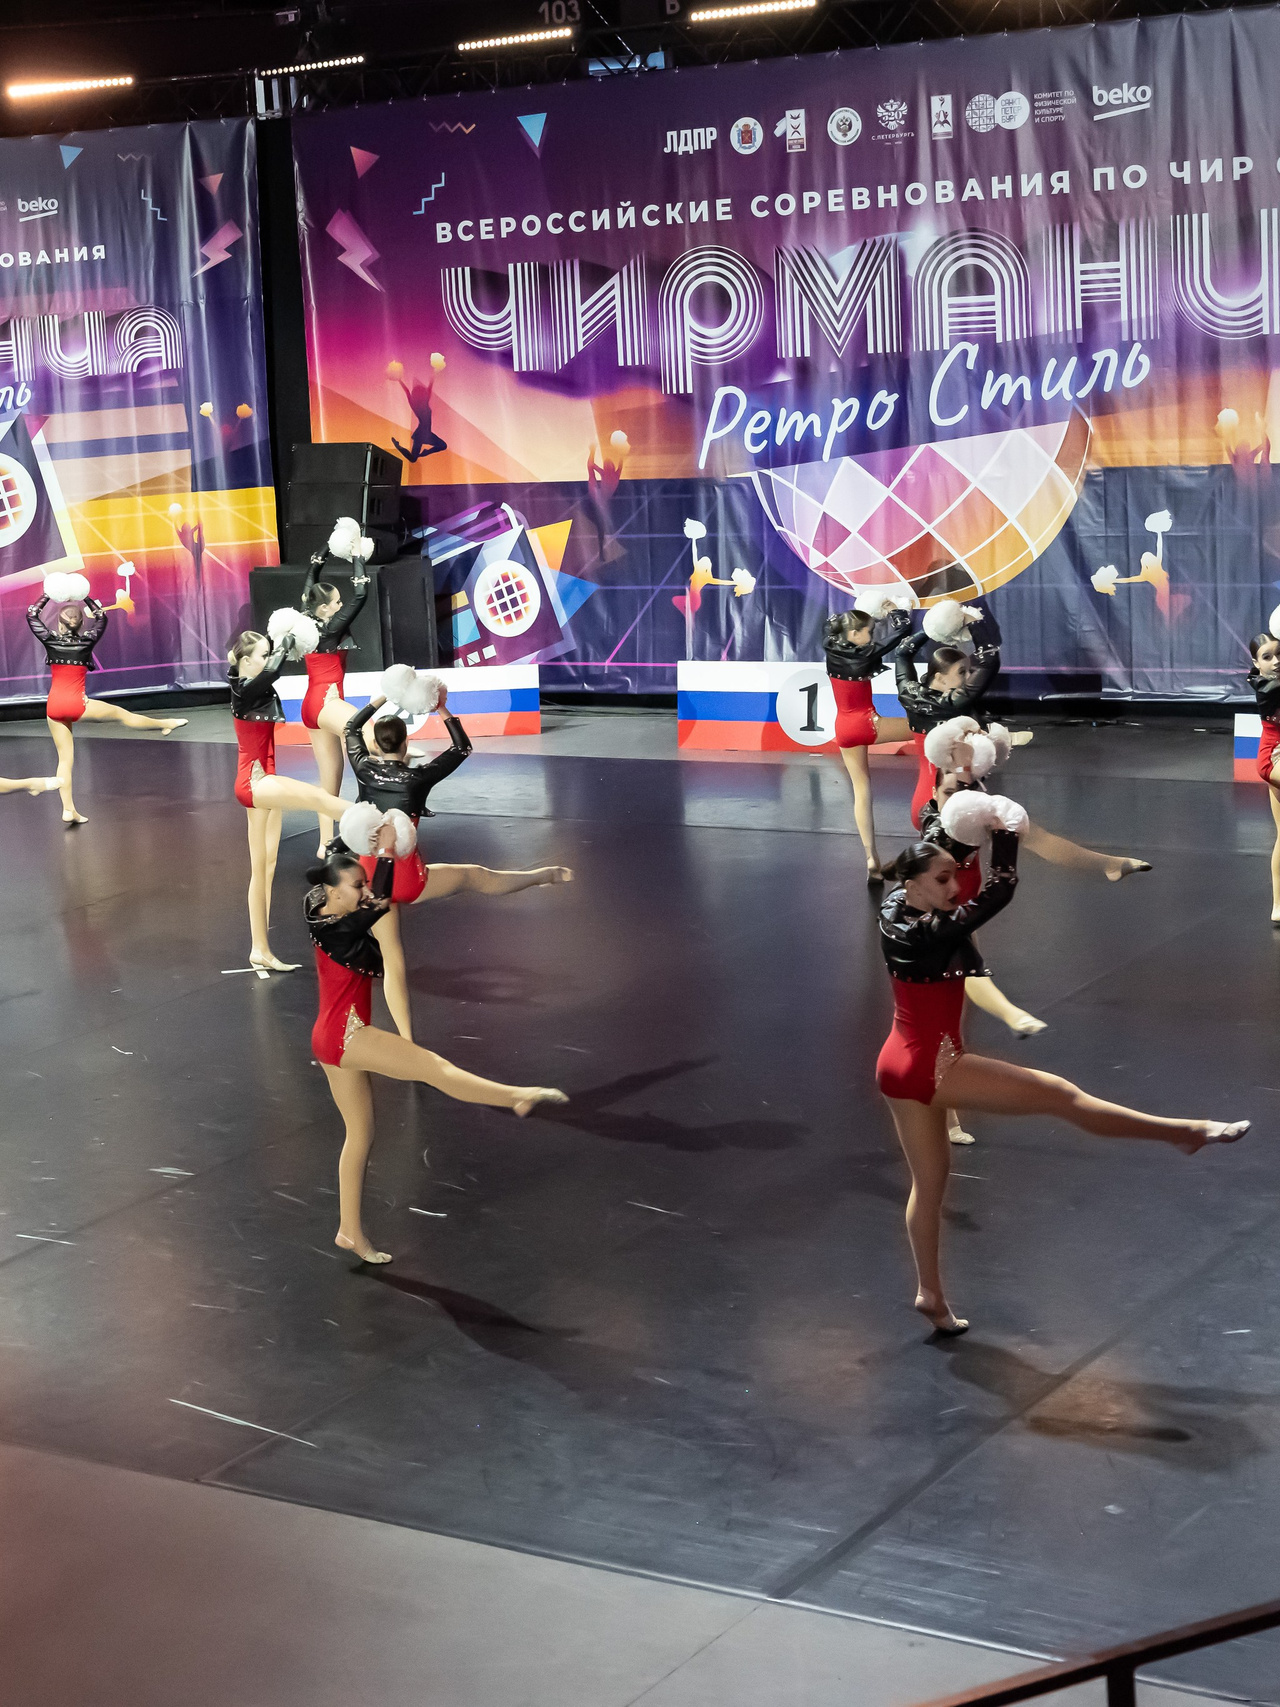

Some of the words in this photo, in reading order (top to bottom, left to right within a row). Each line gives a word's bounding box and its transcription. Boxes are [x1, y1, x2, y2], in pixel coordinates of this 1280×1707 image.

[537, 0, 581, 24] 103
[1033, 90, 1064, 99] КОМИТЕТ
[1064, 89, 1075, 97] ПО
[1033, 97, 1077, 107] ФИЗИЧЕСКОЙ
[1092, 82, 1152, 107] beko
[1034, 106, 1064, 116] КУЛЬТУРЕ
[1040, 114, 1066, 123] СПОРТУ
[663, 126, 718, 156] ЛДПР
[17, 196, 59, 213] beko
[435, 198, 733, 244] ВСЕРОССИЙСКИЕ
[750, 170, 1070, 218] СОРЕВНОВАНИЯ
[1093, 164, 1148, 191] ПО
[1169, 156, 1254, 185] ЧИР
[698, 384, 900, 470] Ретро
[928, 341, 1152, 427] Стиль
[798, 682, 825, 732] 1
